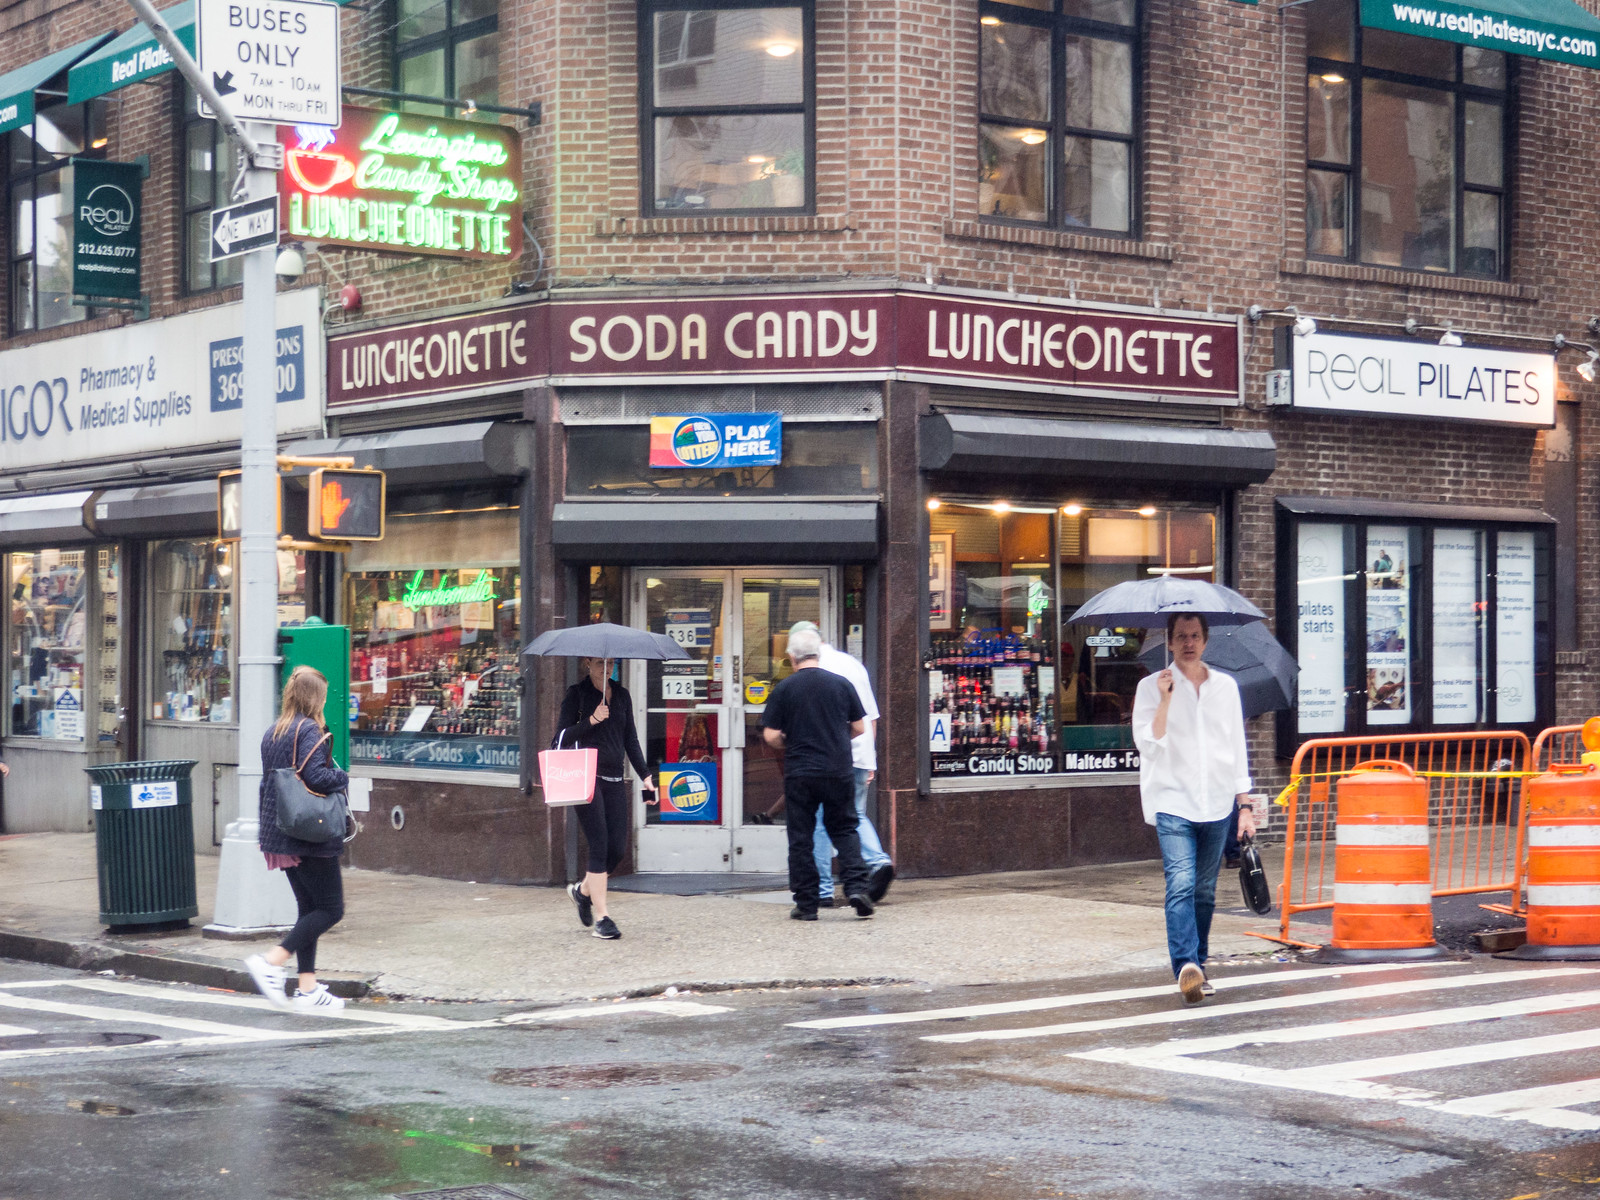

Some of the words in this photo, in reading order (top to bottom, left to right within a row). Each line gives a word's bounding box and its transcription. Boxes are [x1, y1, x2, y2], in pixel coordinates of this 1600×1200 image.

[229, 5, 307, 34] BUSES
[1393, 3, 1596, 57] www.realpilatesnyc.com
[237, 40, 300, 68] ONLY
[112, 53, 138, 83] Real
[243, 94, 274, 110] MON
[277, 100, 303, 113] THRU
[306, 100, 328, 115] FRI
[359, 113, 508, 171] Lexington
[355, 153, 446, 206] Candy
[445, 165, 519, 211] Shop
[103, 223, 131, 231] PILATES
[220, 221, 239, 242] ONE
[248, 212, 270, 236] WAY
[289, 192, 512, 255] LUNCHEONETTE
[78, 243, 136, 257] 212.625.0777
[78, 263, 136, 274] realpilatesnyc.com
[569, 312, 707, 363] SODA
[724, 308, 878, 358] CANDY
[927, 309, 1213, 378] LUNCHEONETTE
[341, 319, 528, 391] LUNCHEONETTE
[80, 363, 144, 392] Pharmacy
[147, 355, 157, 381] &
[1418, 361, 1540, 406] PILATES
[80, 398, 130, 430] Medical
[133, 391, 192, 427] Supplies
[725, 425, 770, 440] PLAY
[724, 440, 776, 457] HERE.
[1298, 600, 1334, 619] pilates
[1303, 620, 1334, 633] starts
[1089, 636, 1123, 645] TELEPHONE
[665, 682, 693, 695] 128
[931, 718, 946, 741] A
[428, 743, 464, 763] Sodas
[934, 760, 966, 772] Lexington
[968, 756, 1014, 775] Candy
[1017, 755, 1053, 773] Shop
[1066, 753, 1117, 770] Malteds
